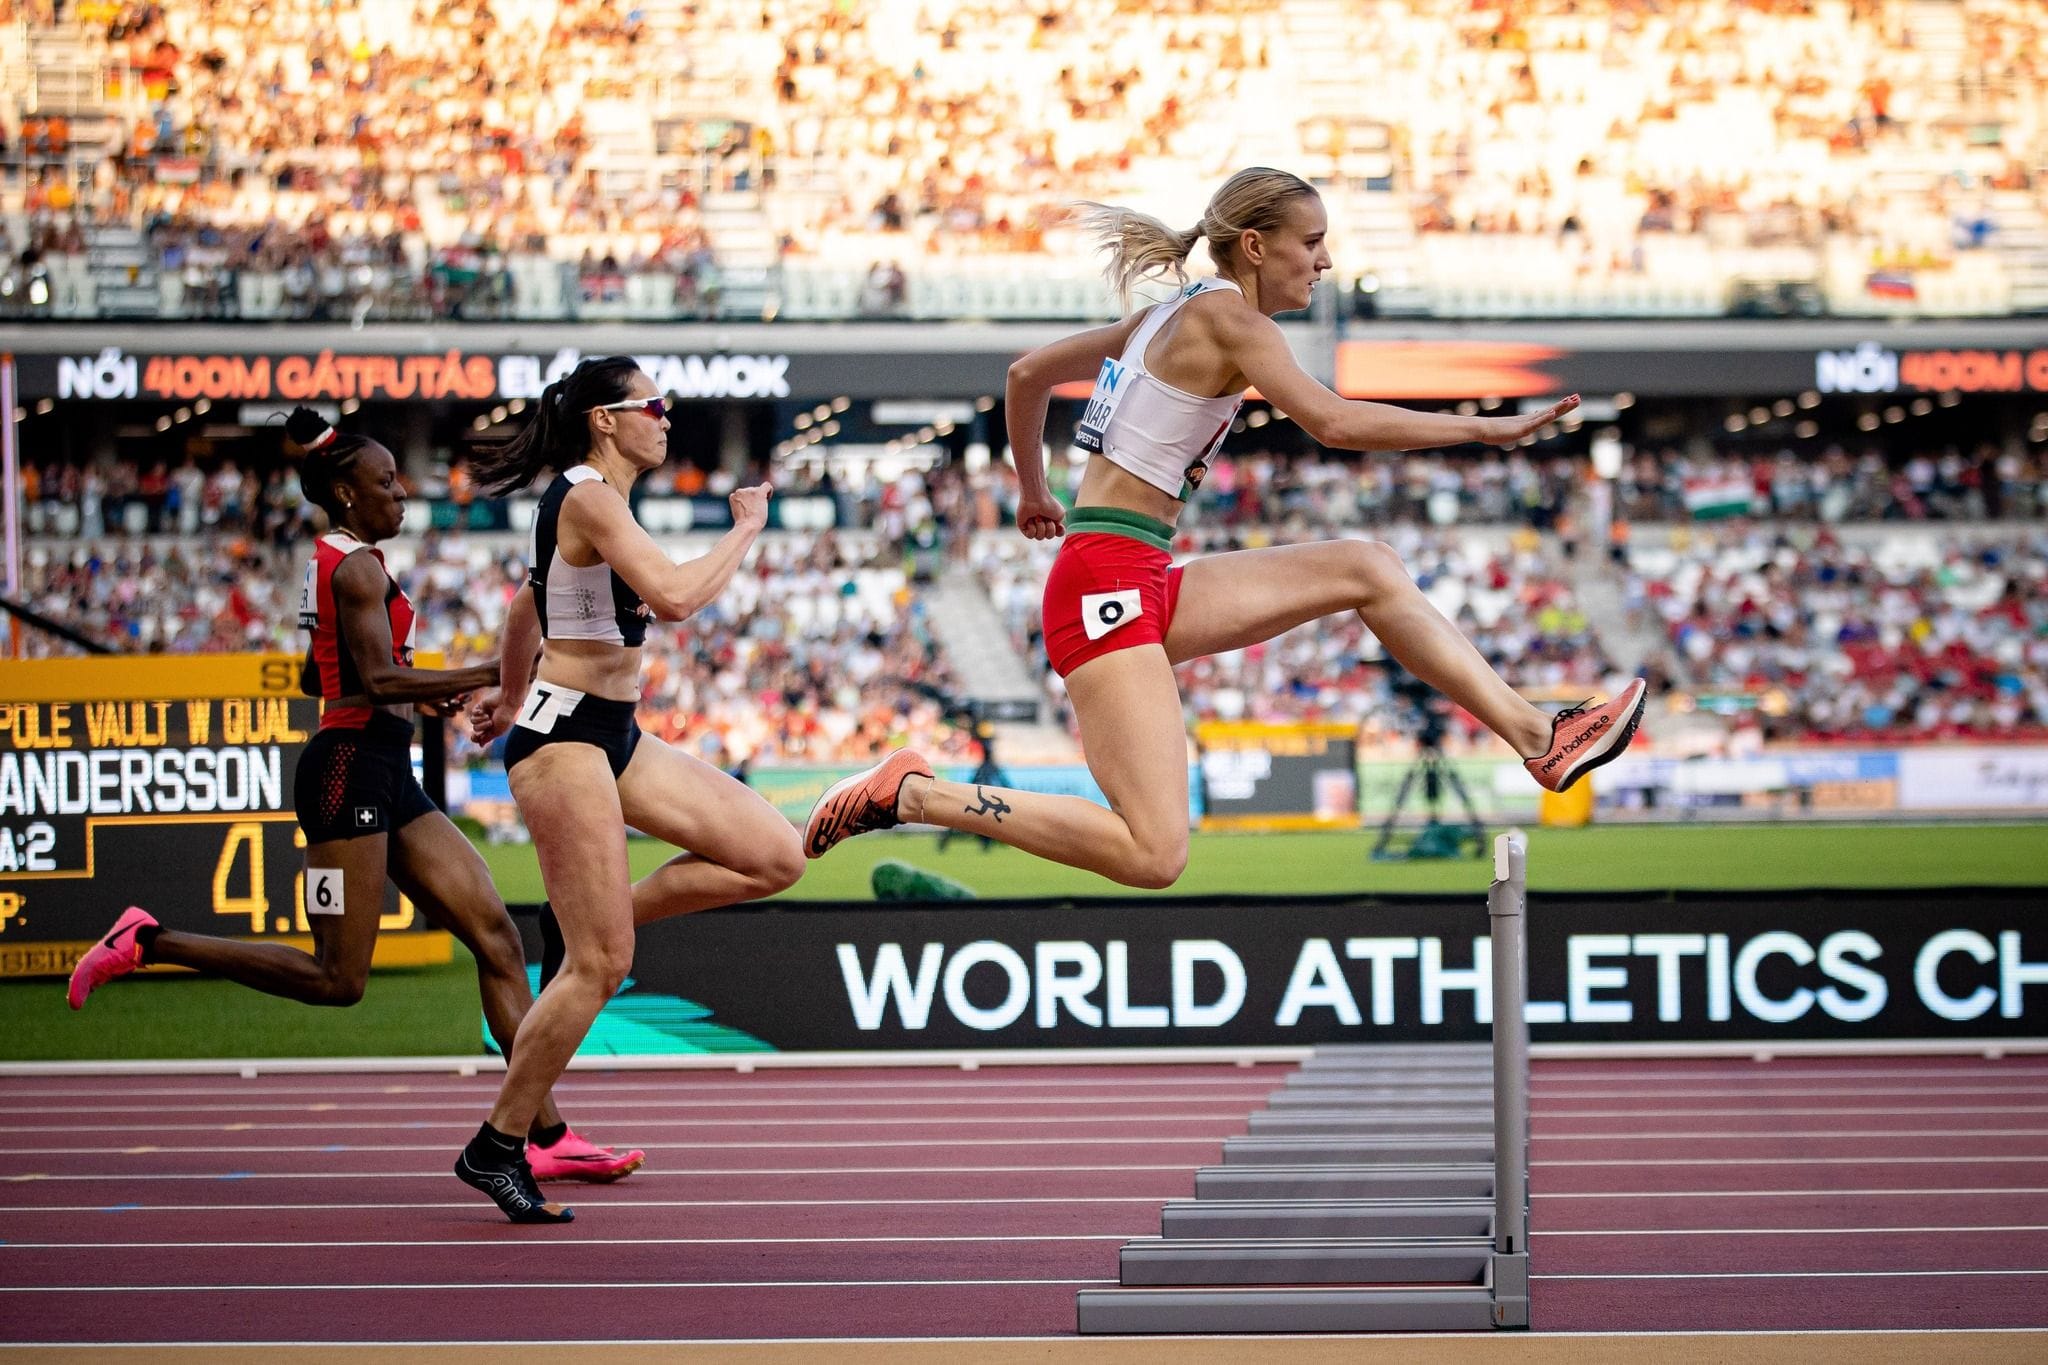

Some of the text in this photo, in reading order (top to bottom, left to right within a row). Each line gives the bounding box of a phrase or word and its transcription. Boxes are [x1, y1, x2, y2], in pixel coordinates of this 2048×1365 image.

[58, 346, 137, 399] NŐI
[144, 356, 271, 399] 400M
[276, 349, 496, 399] GÁTFUTÁS
[0, 702, 73, 748] POLE
[85, 700, 172, 748] VAULT
[187, 698, 211, 745] W
[528, 689, 552, 721] 7
[1541, 715, 1610, 775] new balance
[0, 746, 282, 816] ANDERSSON
[836, 940, 1248, 1031] WORLD
[1914, 928, 2048, 1021] CH
